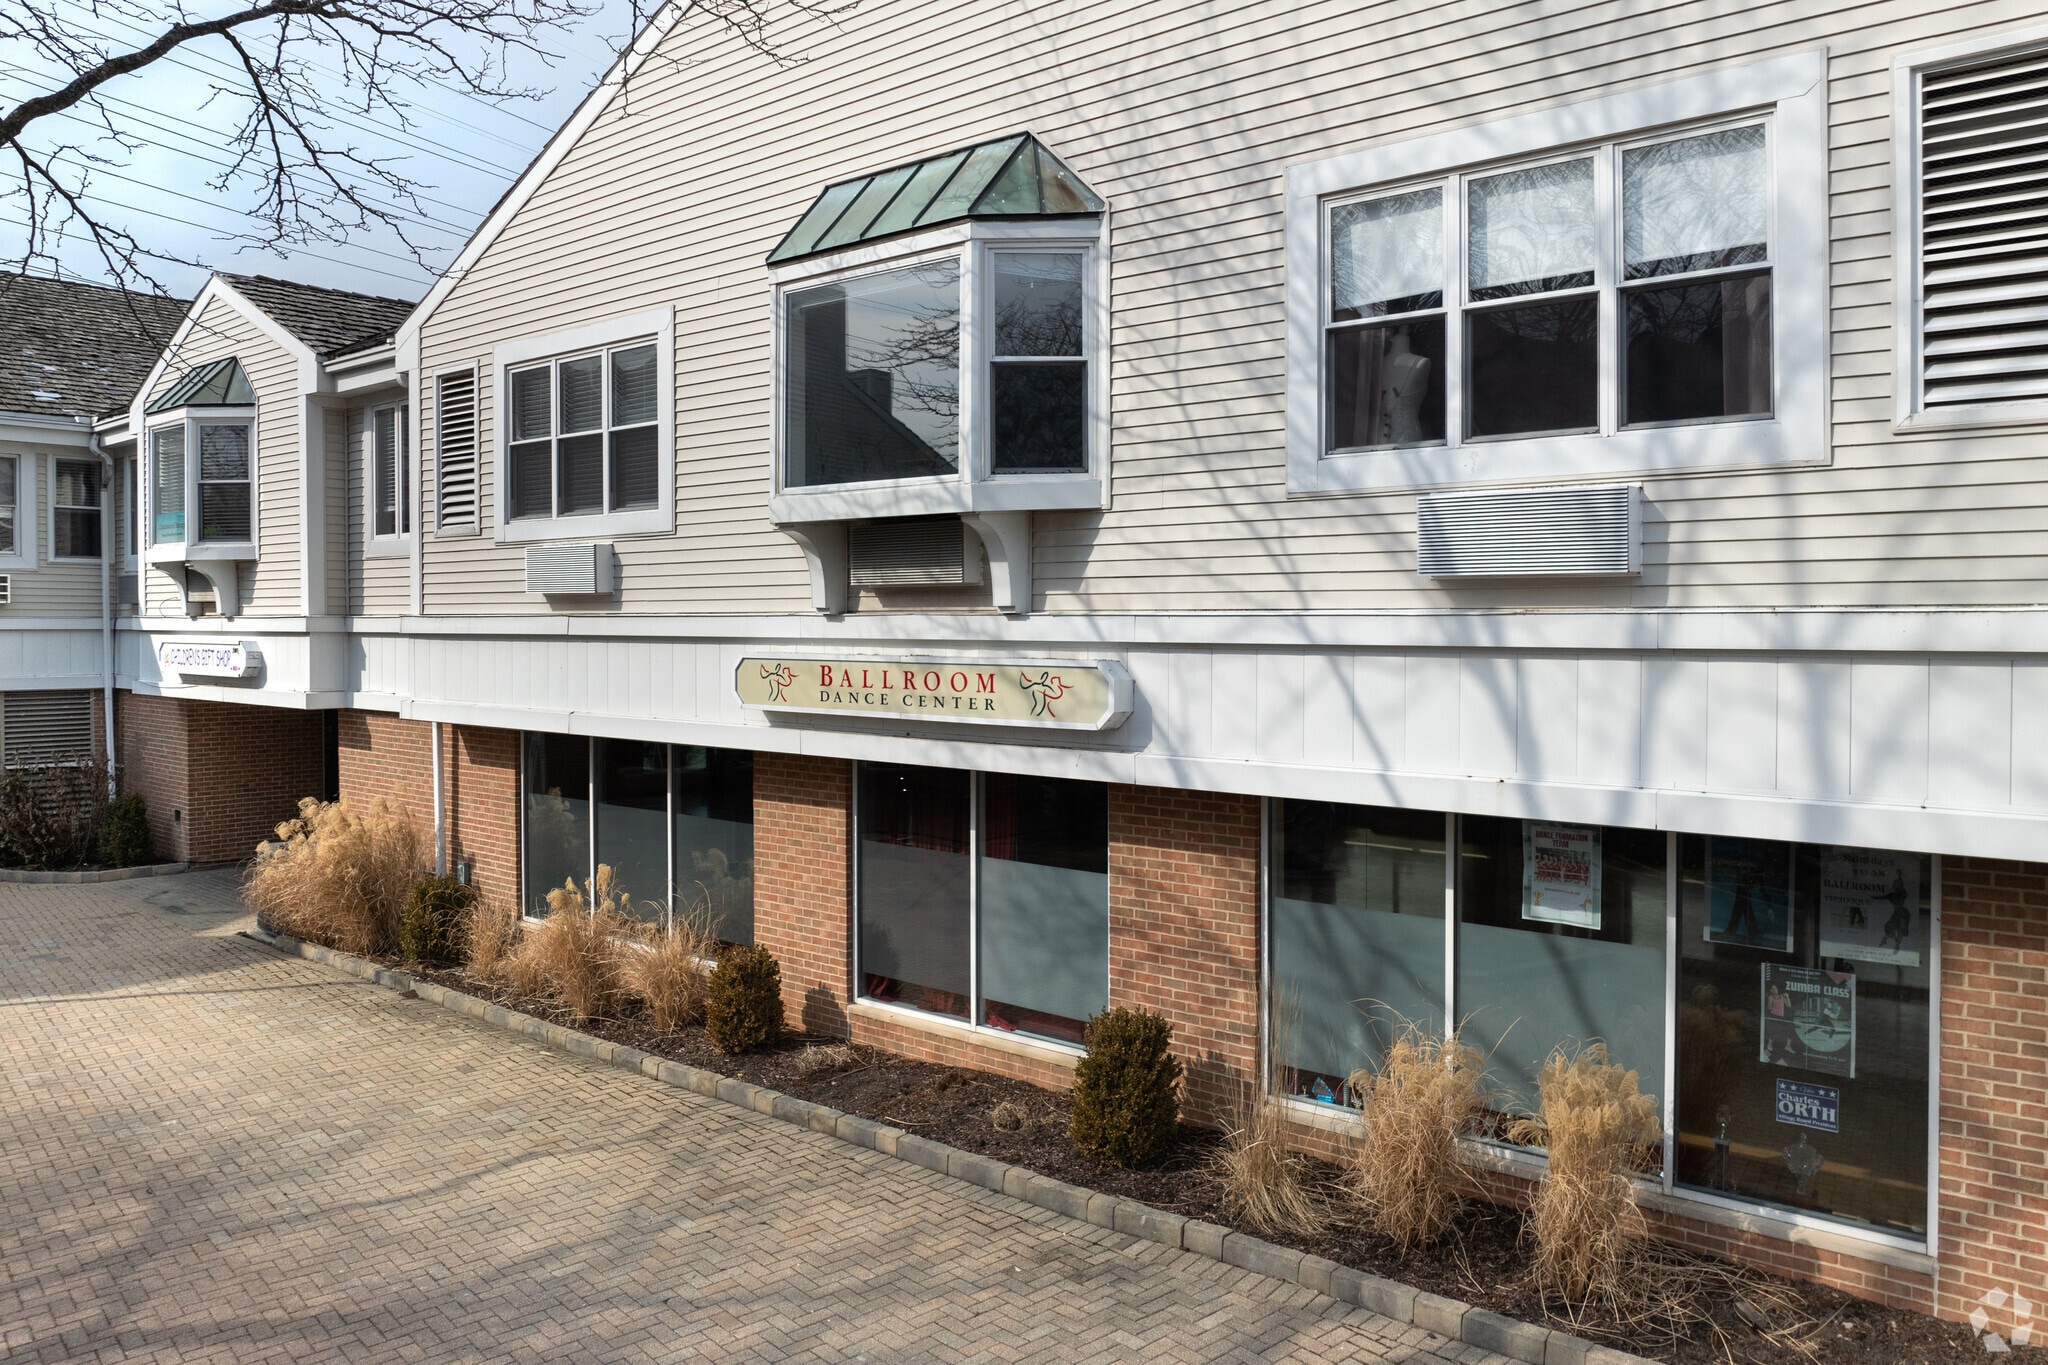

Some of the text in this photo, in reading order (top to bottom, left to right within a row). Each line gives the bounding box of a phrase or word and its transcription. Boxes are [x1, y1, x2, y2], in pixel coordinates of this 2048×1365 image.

[201, 648, 215, 666] GIFT
[216, 649, 232, 667] SHOP
[819, 664, 996, 694] BALLROOM
[820, 690, 996, 711] DANCE CENTER
[1535, 830, 1588, 843] DANCE FORMATION
[1553, 839, 1569, 849] TEAM
[1842, 854, 1895, 868] Saturdays
[1823, 879, 1886, 894] BALLROOM
[1785, 980, 1850, 999] ZUMBA CLASS
[1778, 1092, 1820, 1106] Charles
[1778, 1100, 1837, 1123] ORTH
[1778, 1113, 1837, 1129] Village Board President
